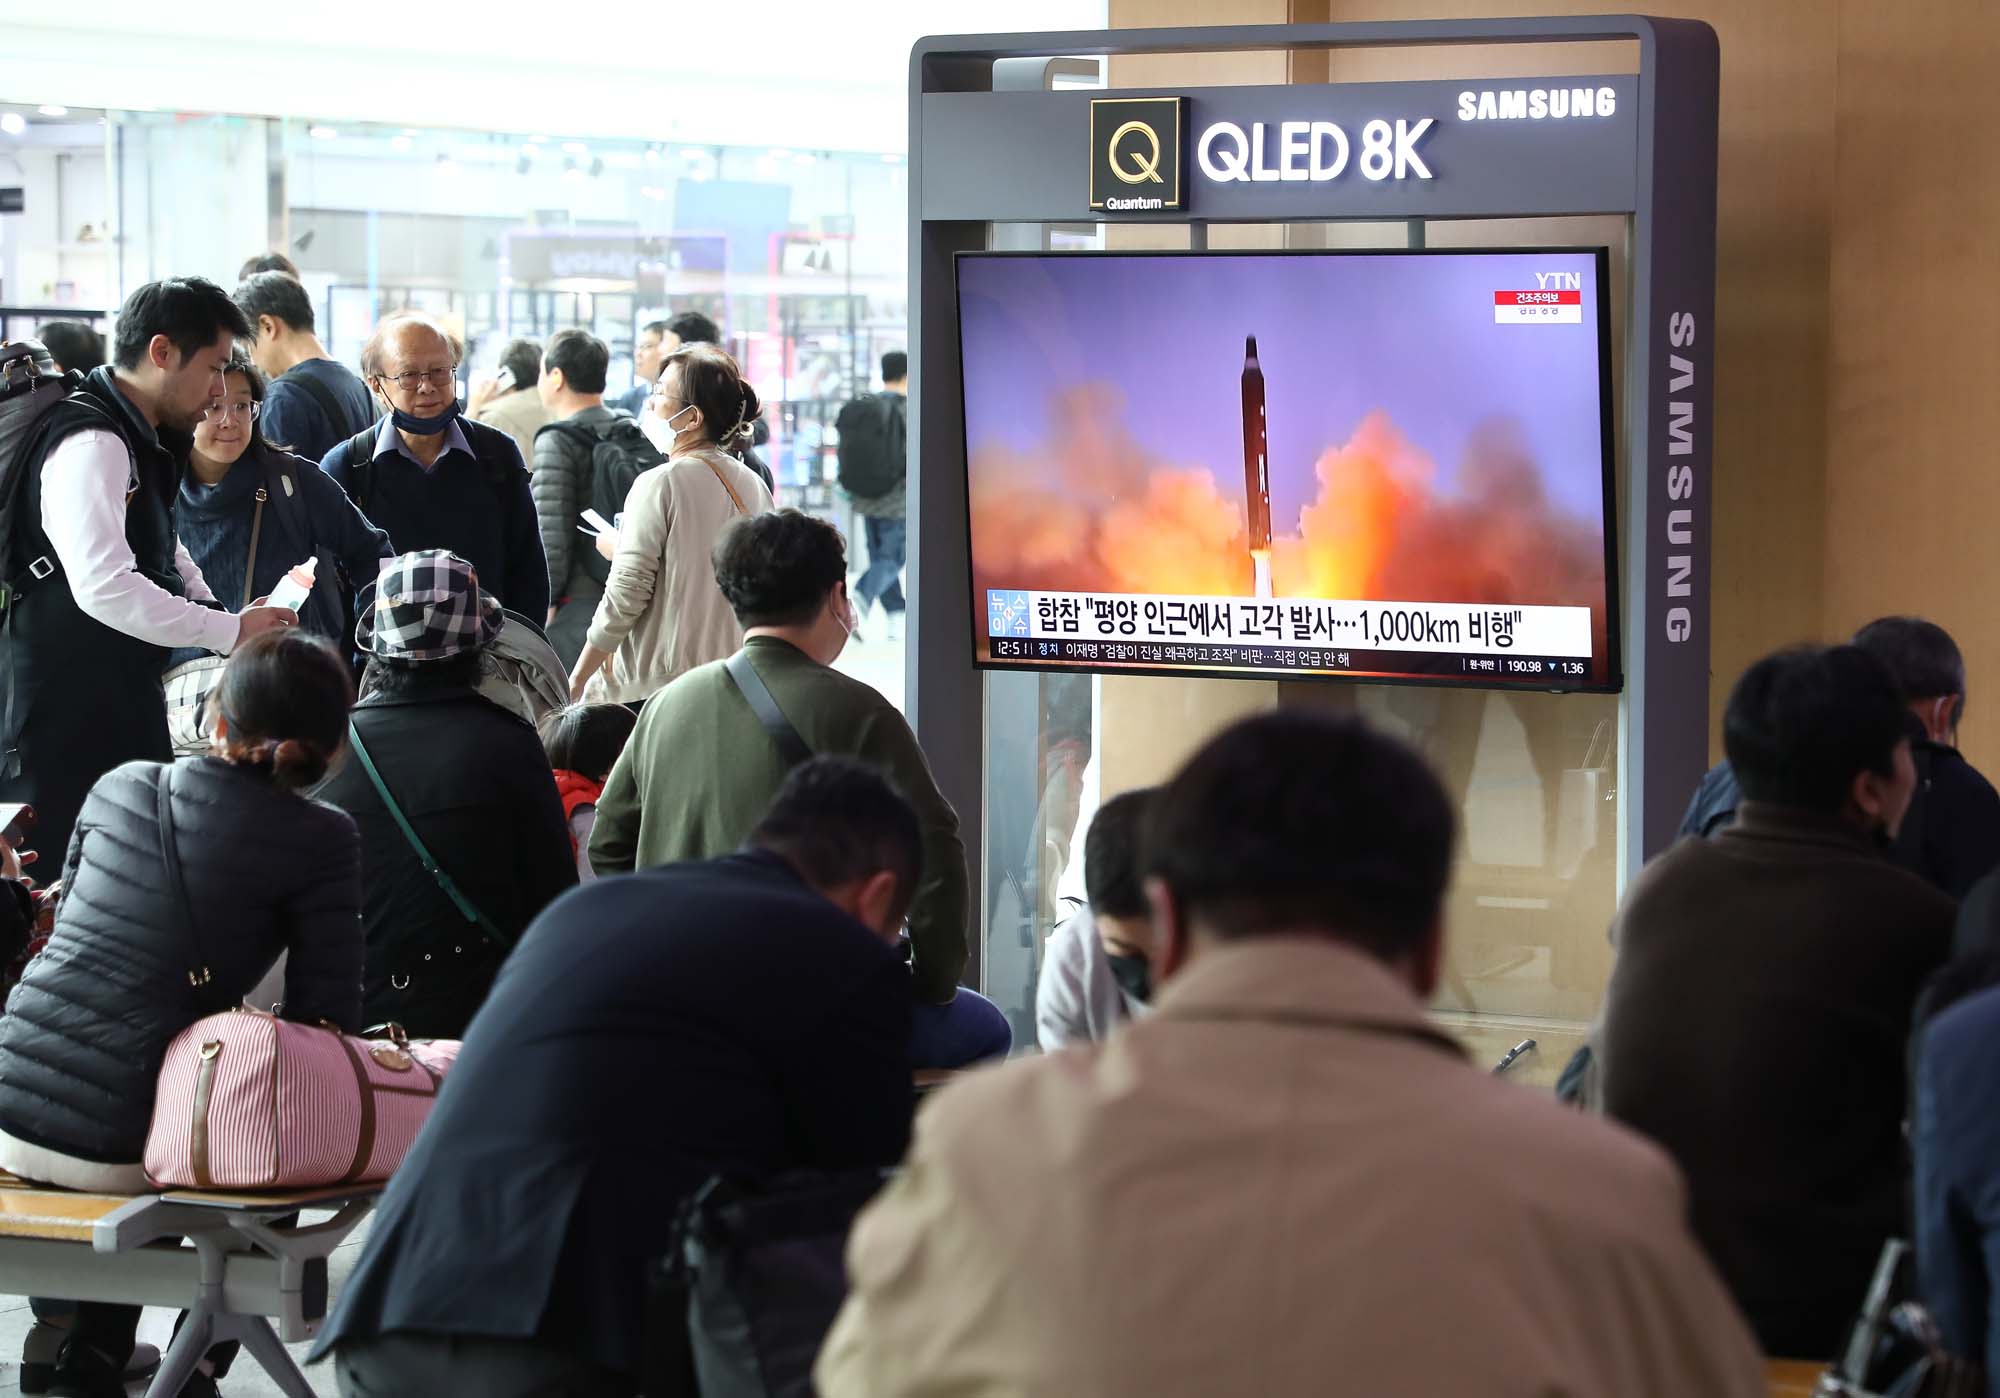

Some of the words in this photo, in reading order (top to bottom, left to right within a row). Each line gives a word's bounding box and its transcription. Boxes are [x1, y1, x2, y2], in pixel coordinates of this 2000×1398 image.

[1457, 87, 1616, 121] SAMSUNG
[1108, 121, 1164, 184] Q
[1197, 121, 1350, 182] QLED
[1360, 118, 1434, 181] 8K
[1106, 197, 1162, 210] Quantum
[1535, 272, 1581, 290] YTN
[1516, 292, 1559, 304] 건조주의보
[1666, 311, 1695, 643] SAMSUNG
[1037, 597, 1081, 632] 합참
[1086, 597, 1138, 635] "평양
[1144, 600, 1232, 638] 인근에서
[1239, 604, 1284, 640] 고각
[1468, 610, 1522, 648] 비행"
[1038, 642, 1059, 656] 정치
[1066, 643, 1098, 659] 이재명
[1101, 644, 1138, 660] "검찰이
[1140, 645, 1162, 661] 진실
[1164, 646, 1208, 662] 왜곡하고
[1299, 651, 1322, 666] 언급
[1324, 652, 1335, 667] 안
[1338, 652, 1350, 668] 해
[1507, 661, 1542, 673] 190.98
[1561, 662, 1584, 675] 1.36
